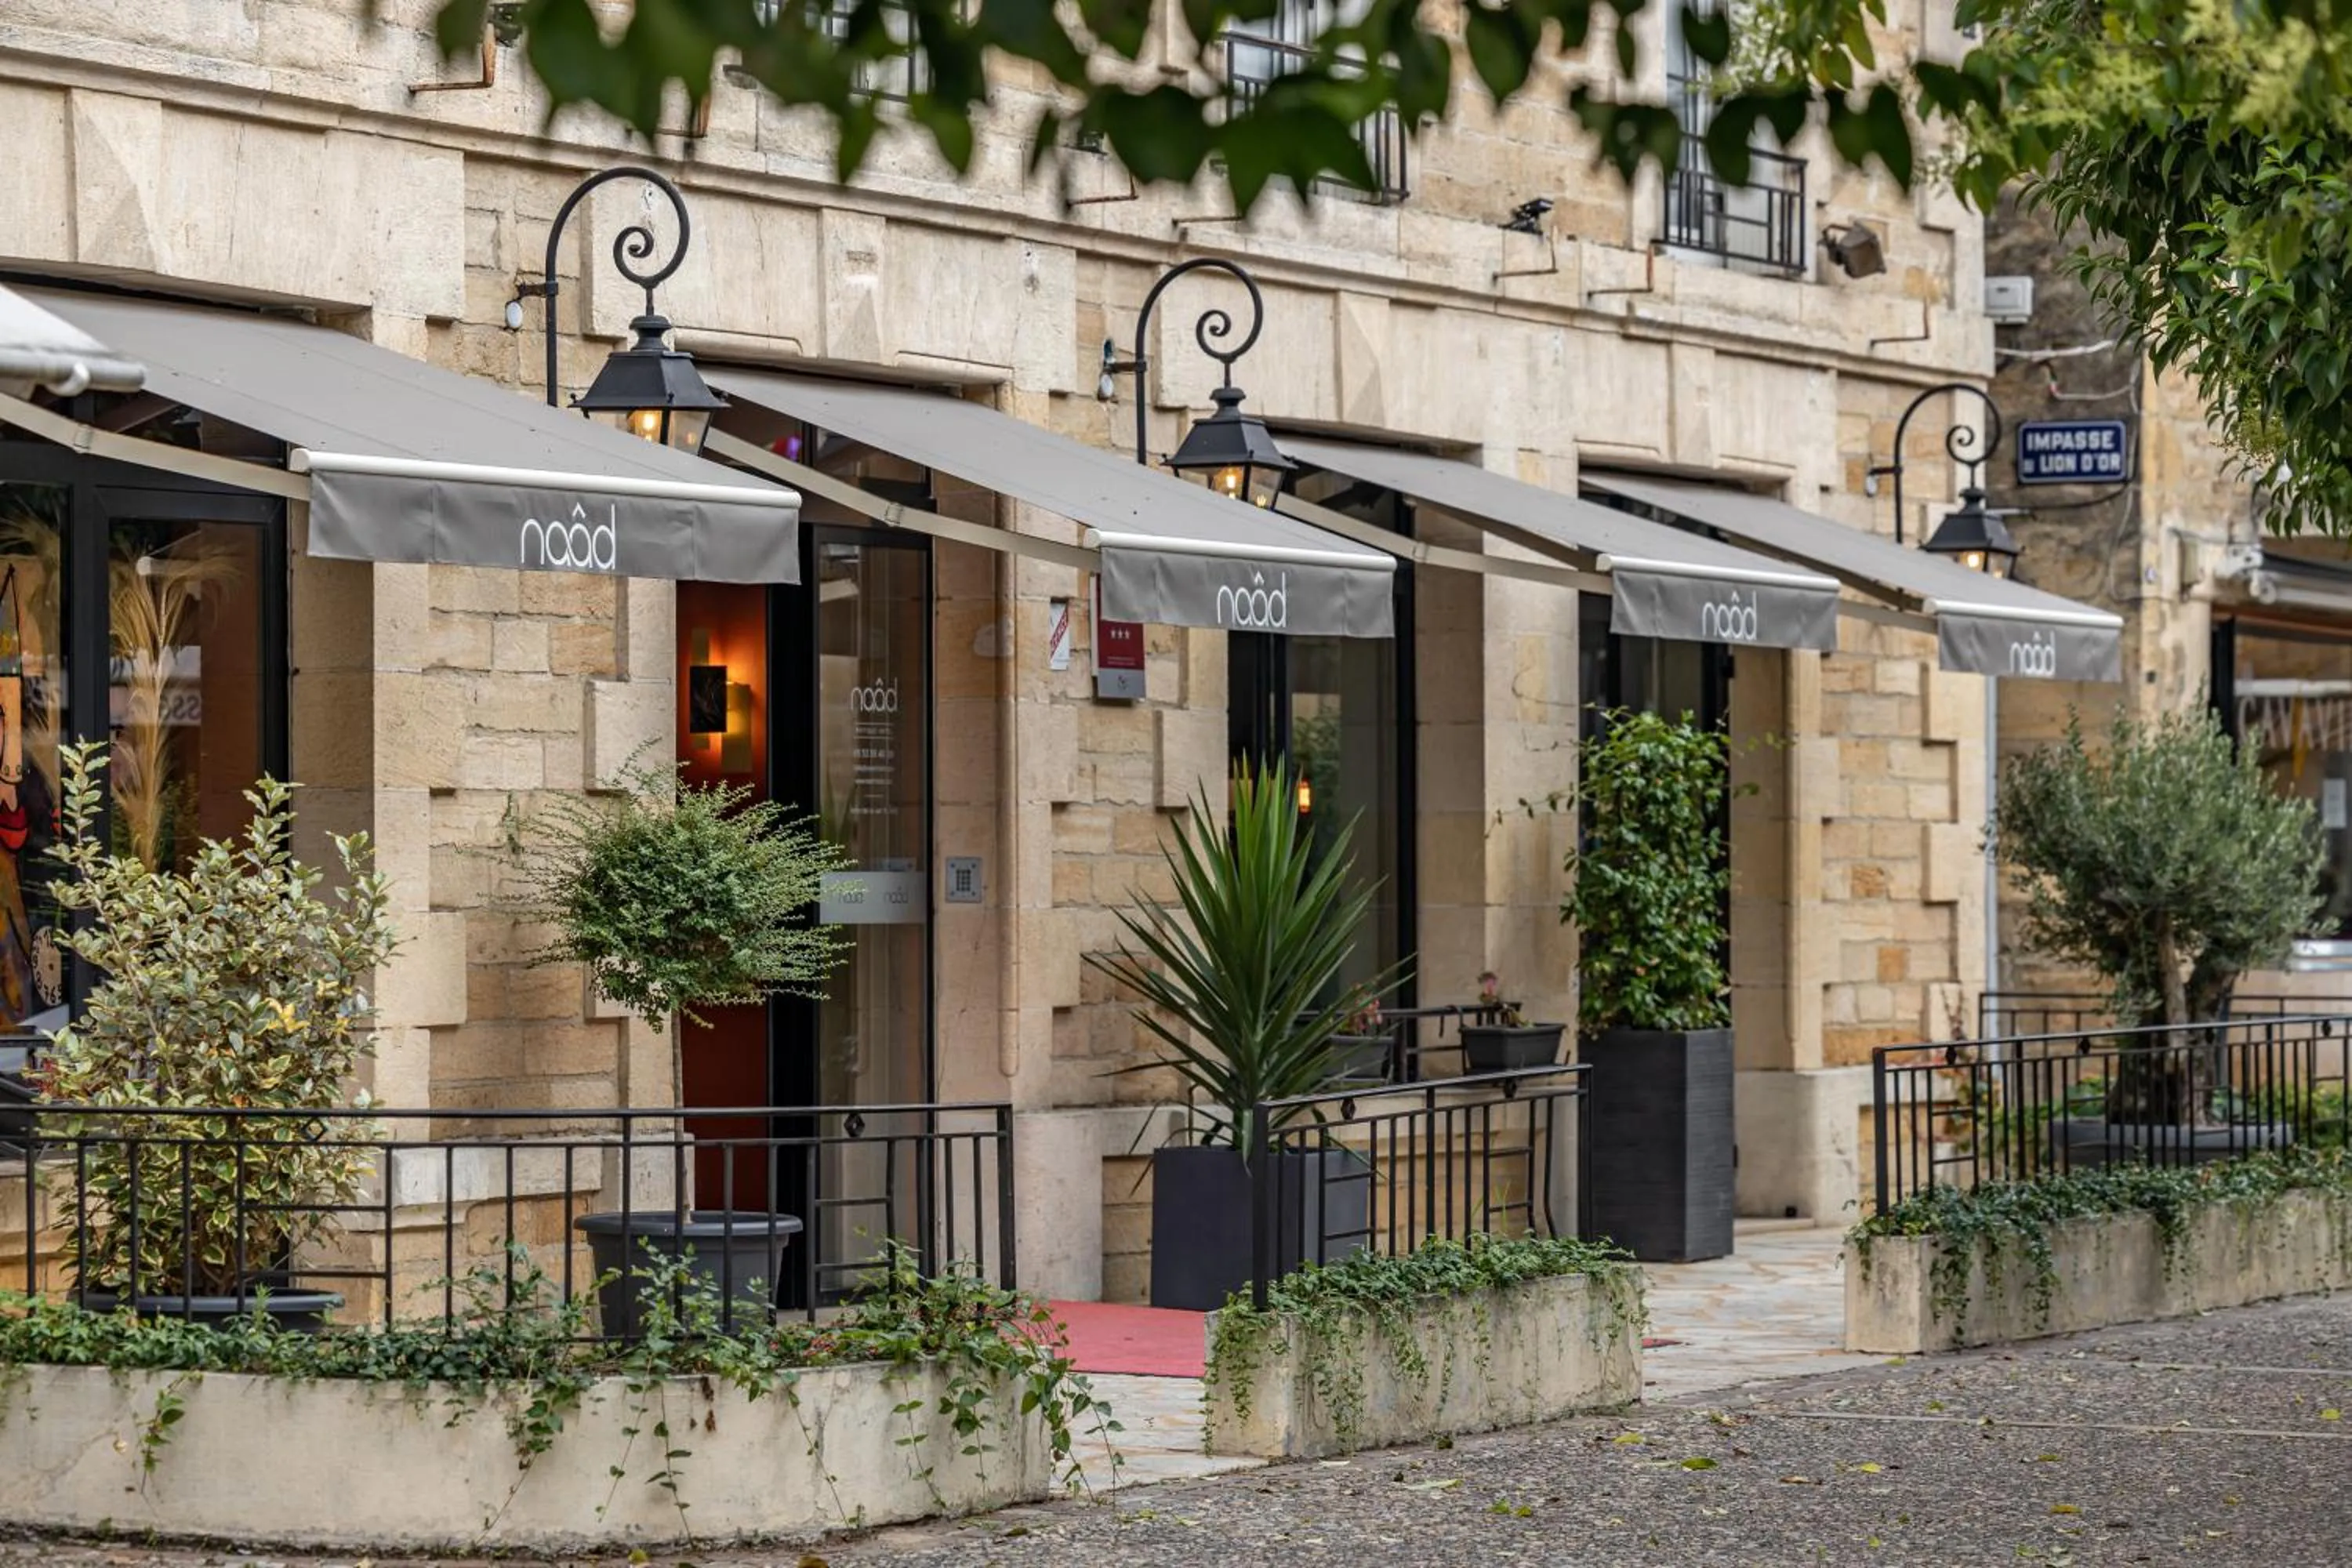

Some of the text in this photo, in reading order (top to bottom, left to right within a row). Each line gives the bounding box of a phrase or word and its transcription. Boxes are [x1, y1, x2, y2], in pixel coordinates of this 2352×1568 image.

[2026, 430, 2114, 451] IMPASSE
[2039, 453, 2077, 474] LION
[2081, 452, 2120, 472] D'OR
